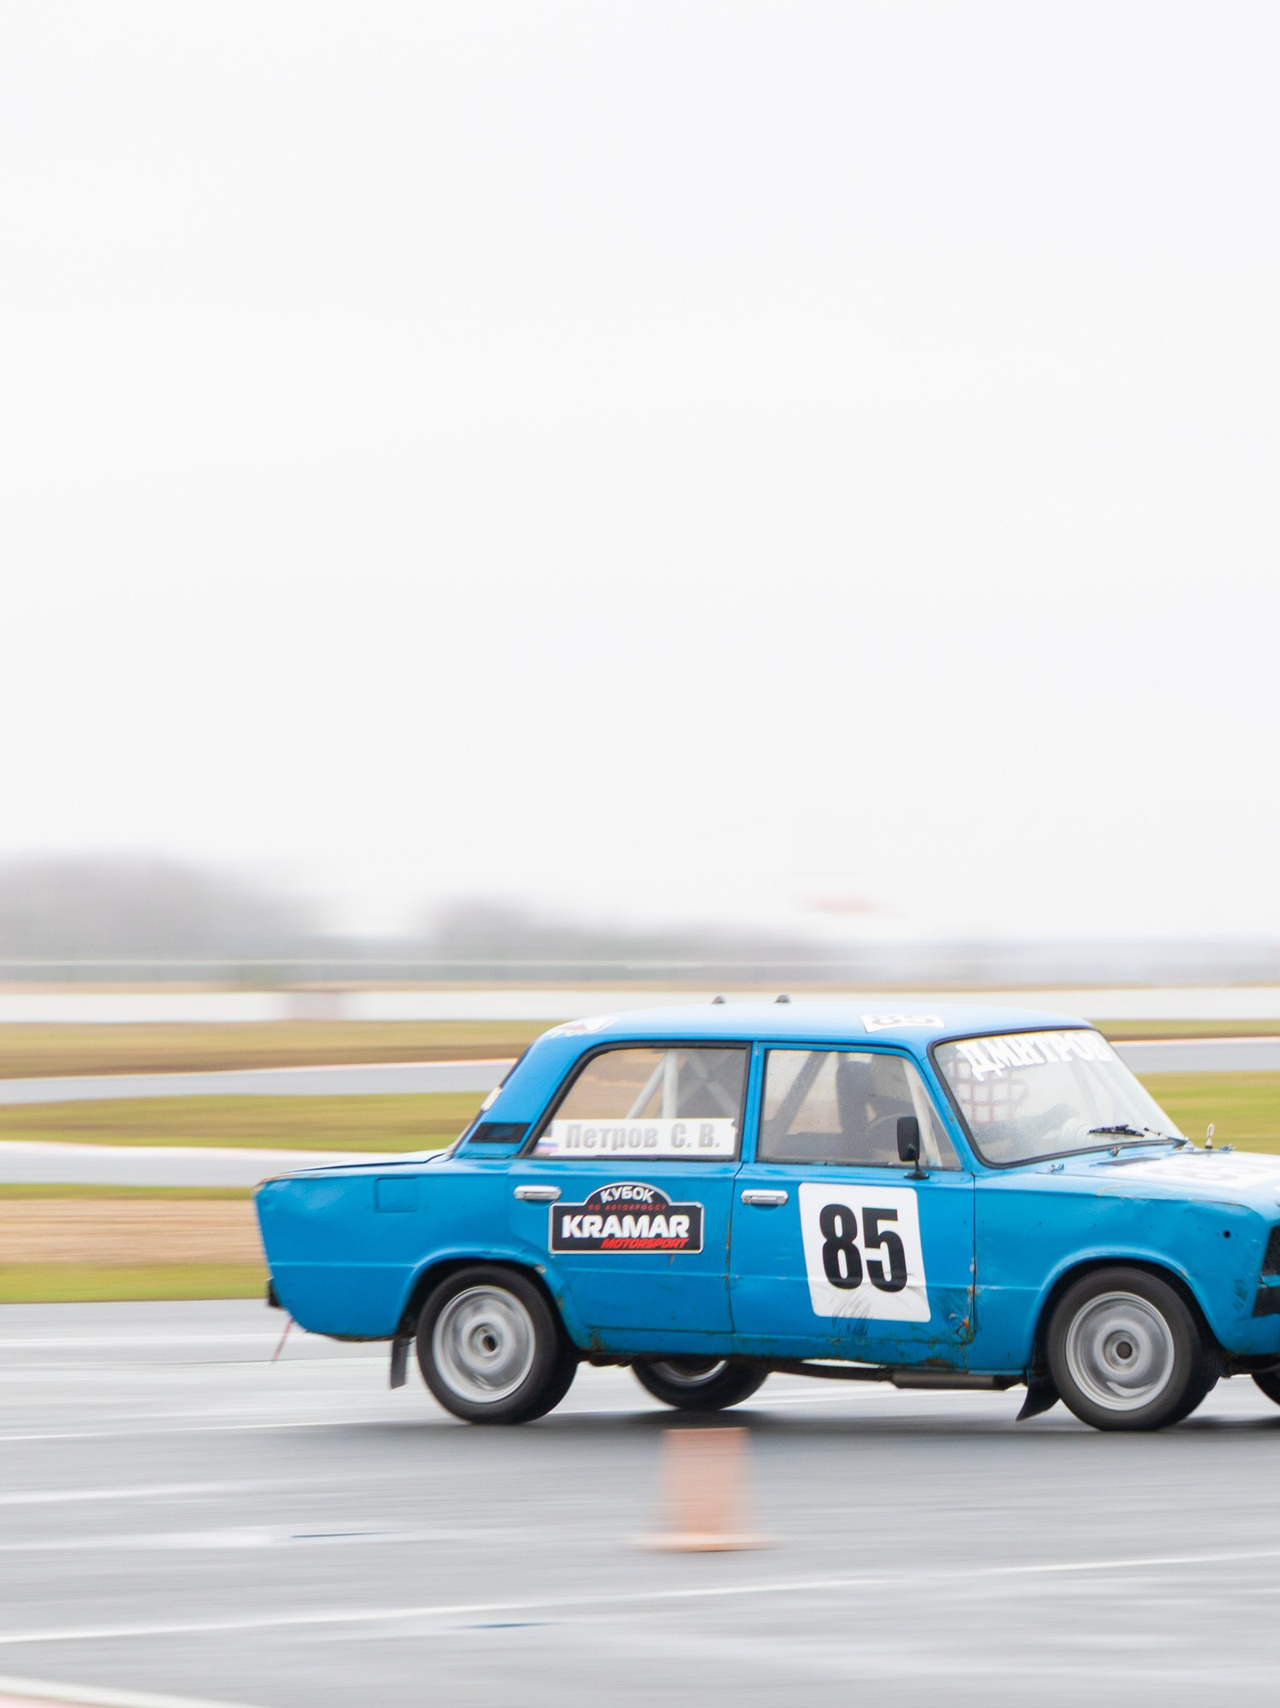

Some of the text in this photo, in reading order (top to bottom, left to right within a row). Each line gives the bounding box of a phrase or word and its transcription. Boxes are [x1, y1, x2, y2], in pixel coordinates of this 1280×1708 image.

[565, 1122, 721, 1151] Петров С. В.
[600, 1186, 655, 1204] КУБОК
[562, 1214, 690, 1239] KRAMAR
[600, 1237, 690, 1250] MOTORSPORT
[819, 1203, 908, 1293] 85
